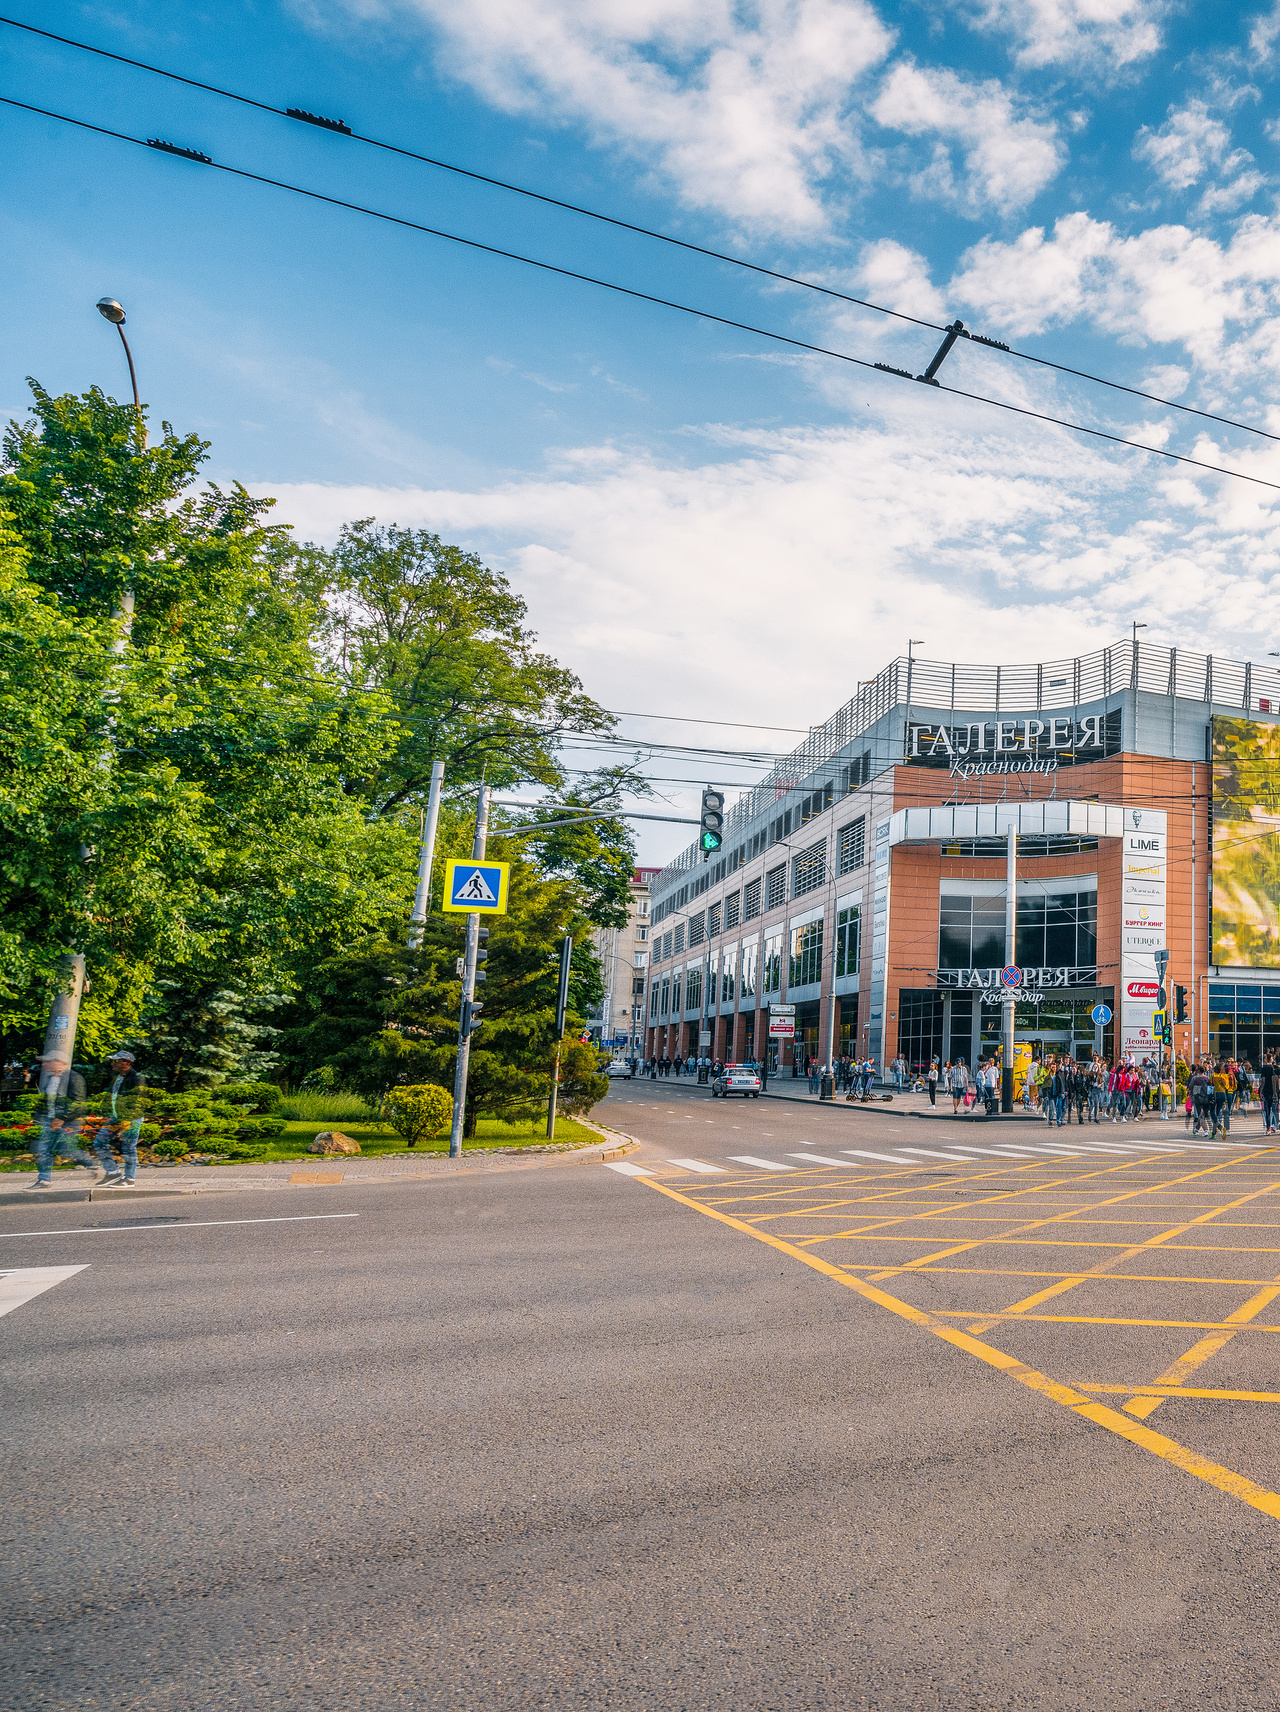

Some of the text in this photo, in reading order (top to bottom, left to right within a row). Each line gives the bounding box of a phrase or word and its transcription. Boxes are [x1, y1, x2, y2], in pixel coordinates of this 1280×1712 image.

[908, 715, 1104, 757] ГАЛЕРЕЯ
[950, 754, 1059, 781] Краснодар
[956, 966, 1071, 988] ГАЛРЕЯ
[979, 988, 1046, 1006] Крадар
